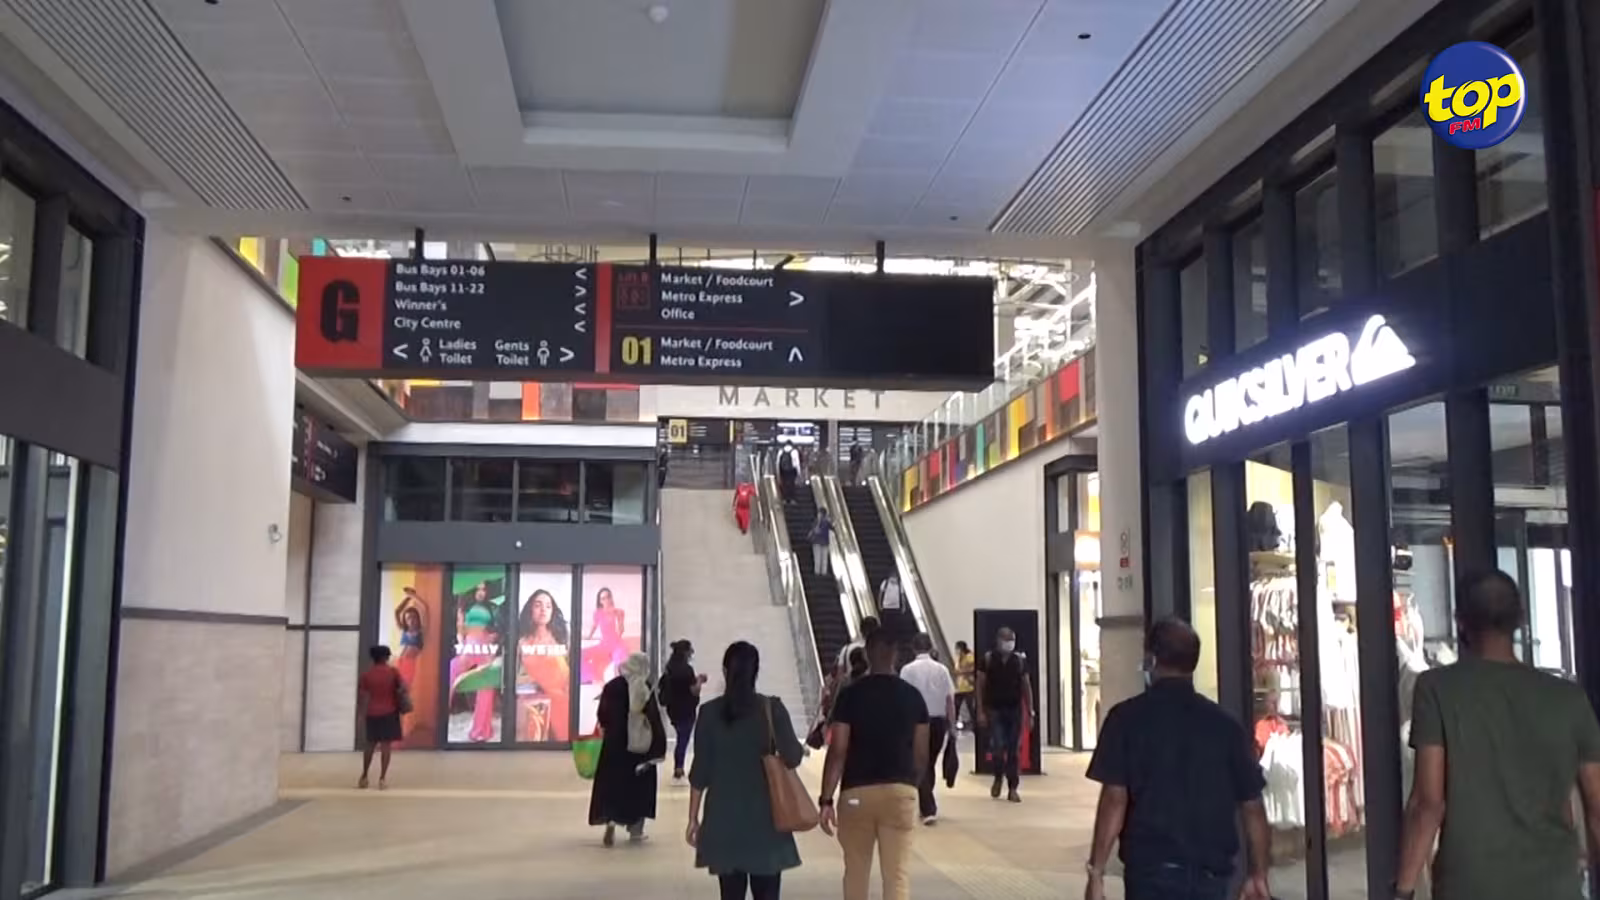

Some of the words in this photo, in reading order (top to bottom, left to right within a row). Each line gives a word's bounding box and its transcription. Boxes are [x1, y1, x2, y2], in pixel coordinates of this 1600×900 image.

[396, 263, 418, 275] Bus
[420, 263, 447, 278] Bays
[450, 264, 485, 277] 01-06
[661, 272, 703, 285] Market
[705, 273, 713, 288] /
[716, 274, 774, 288] Foodcourt
[395, 280, 417, 293] Bus
[420, 281, 447, 296] Bays
[450, 282, 485, 294] 11-22
[394, 298, 447, 311] Winner's
[661, 290, 696, 302] Metro
[699, 291, 743, 305] Express
[319, 280, 360, 343] G
[661, 307, 695, 320] Office
[394, 316, 419, 332] City
[421, 316, 461, 329] Centre
[439, 338, 477, 351] Ladies
[495, 339, 529, 351] Gents
[622, 336, 652, 365] 01
[661, 336, 702, 349] Market
[704, 337, 712, 352] /
[715, 338, 773, 351] Foodcourt
[440, 353, 473, 365] Toilet
[496, 353, 529, 366] Toilet
[661, 355, 695, 366] Metro
[698, 355, 742, 370] Express
[719, 387, 886, 409] MARKET
[454, 643, 499, 655] TALLY
